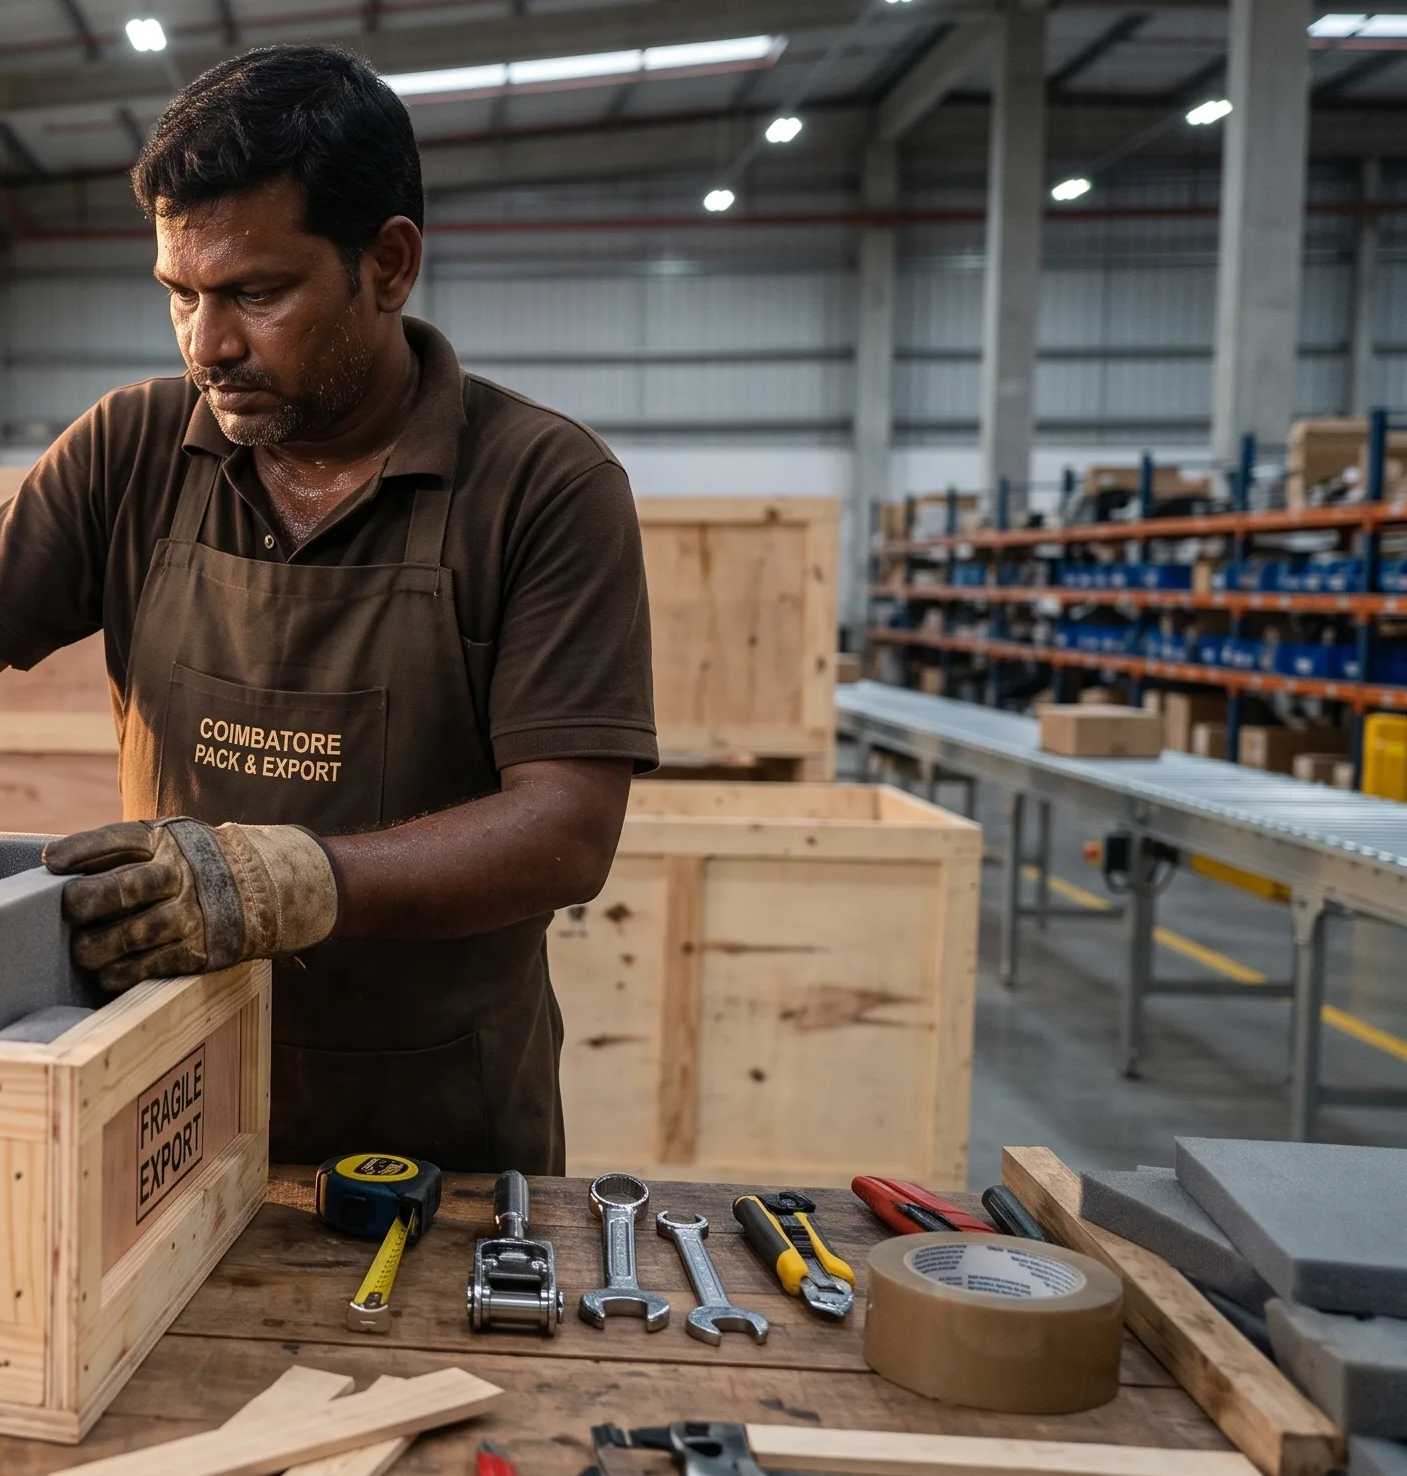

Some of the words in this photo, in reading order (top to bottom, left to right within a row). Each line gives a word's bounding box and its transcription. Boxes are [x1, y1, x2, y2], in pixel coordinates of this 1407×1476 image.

[194, 743, 241, 772] PACK
[244, 754, 257, 775] &
[262, 756, 342, 782] EXPORT
[200, 717, 342, 755] COIMBATORE
[140, 1059, 202, 1150] FRAGILE
[139, 1111, 201, 1207] EXPORT
